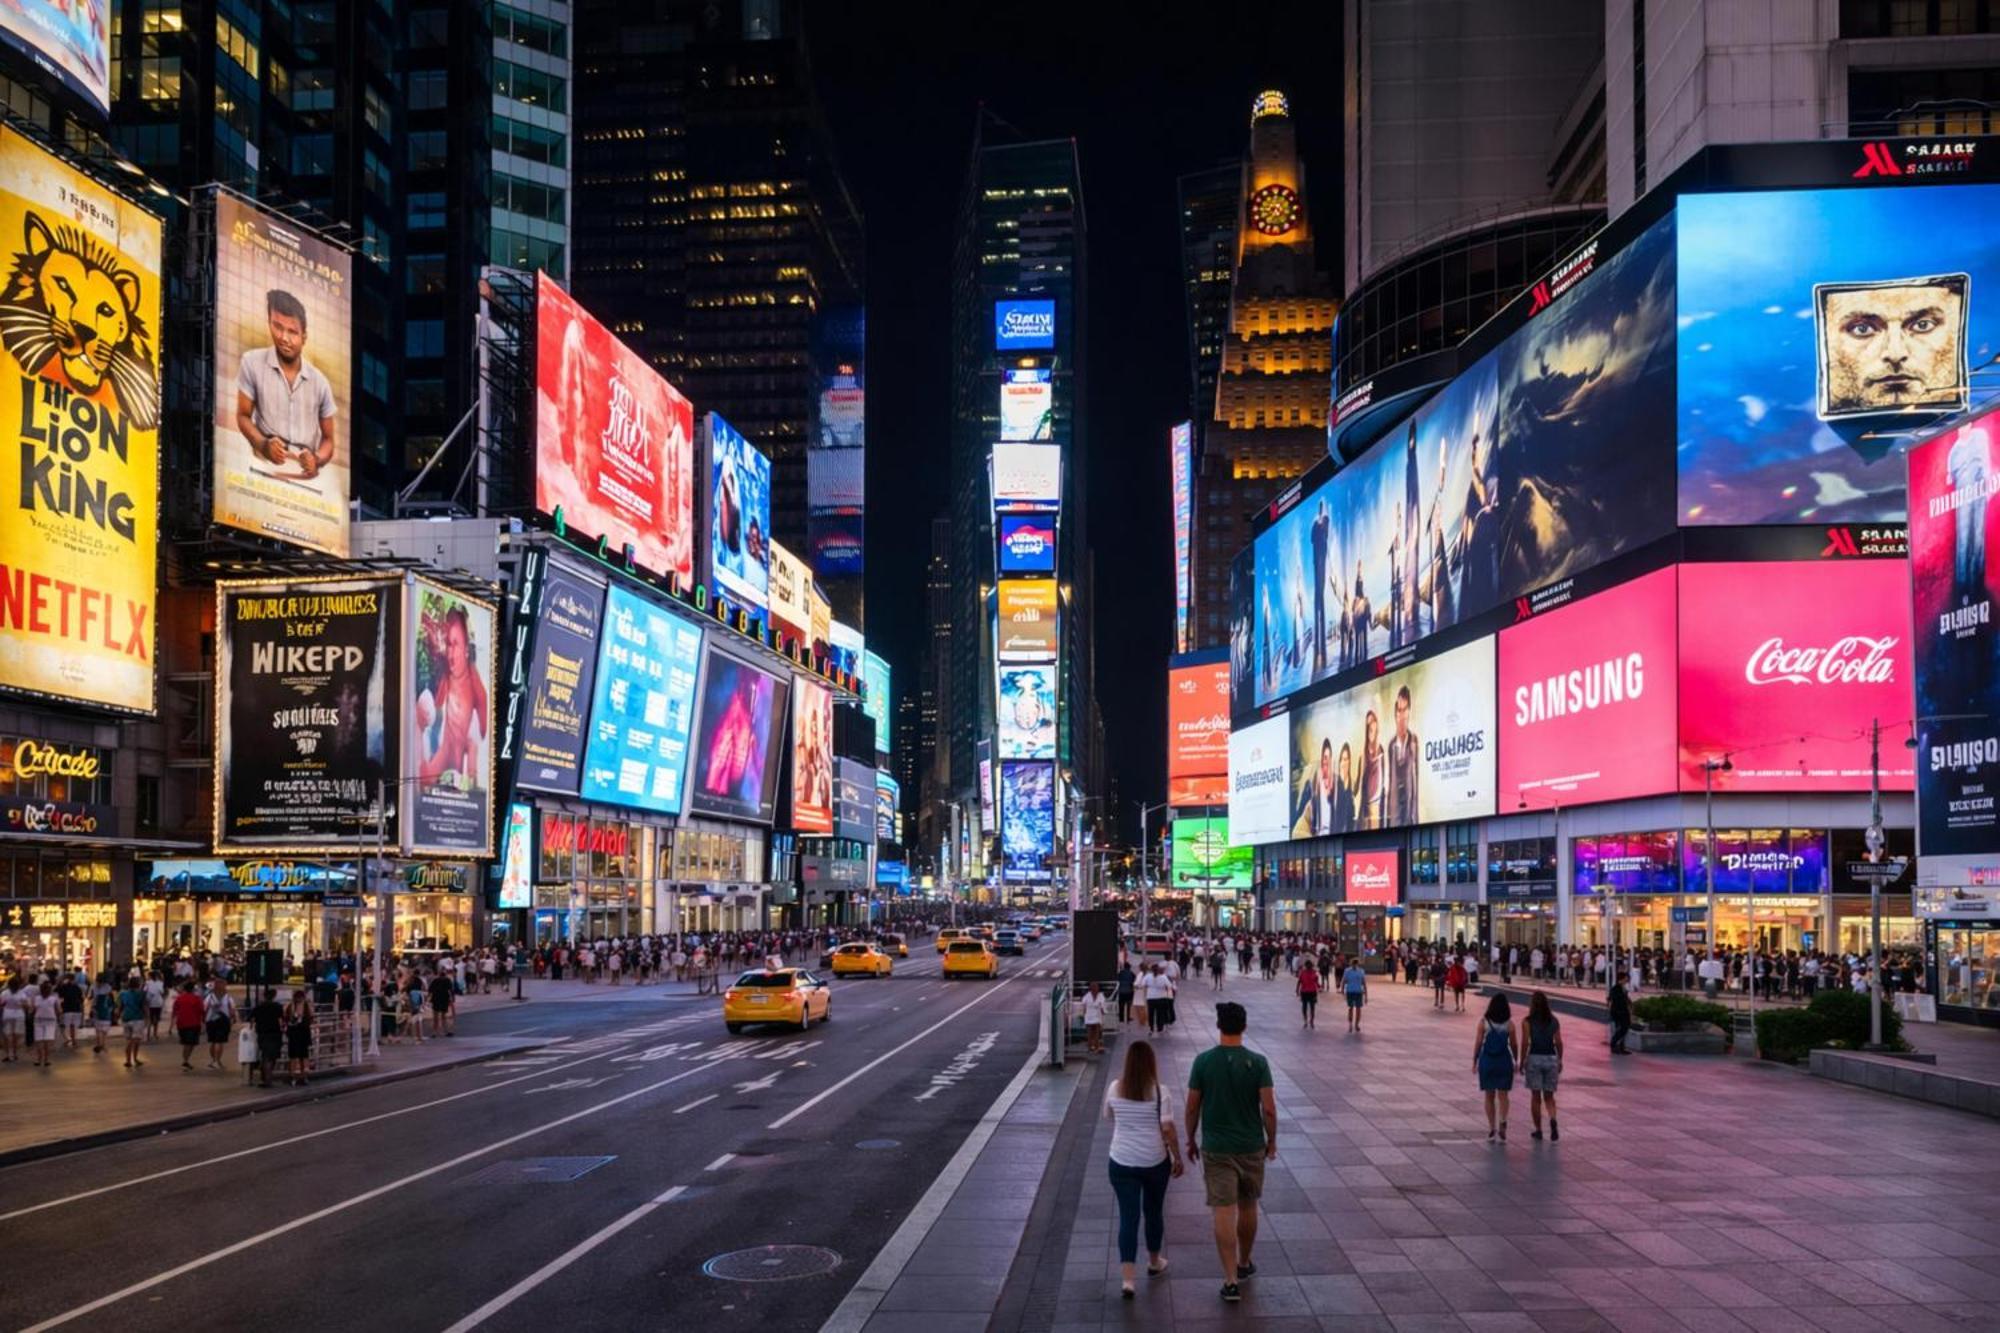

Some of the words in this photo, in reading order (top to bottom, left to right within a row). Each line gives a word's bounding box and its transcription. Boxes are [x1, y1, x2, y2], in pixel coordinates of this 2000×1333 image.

[0, 565, 148, 661] NETFLX
[252, 641, 364, 674] WIKEPD
[1745, 636, 1899, 685] Coca-Cola
[1515, 651, 1644, 727] SAMSUNG
